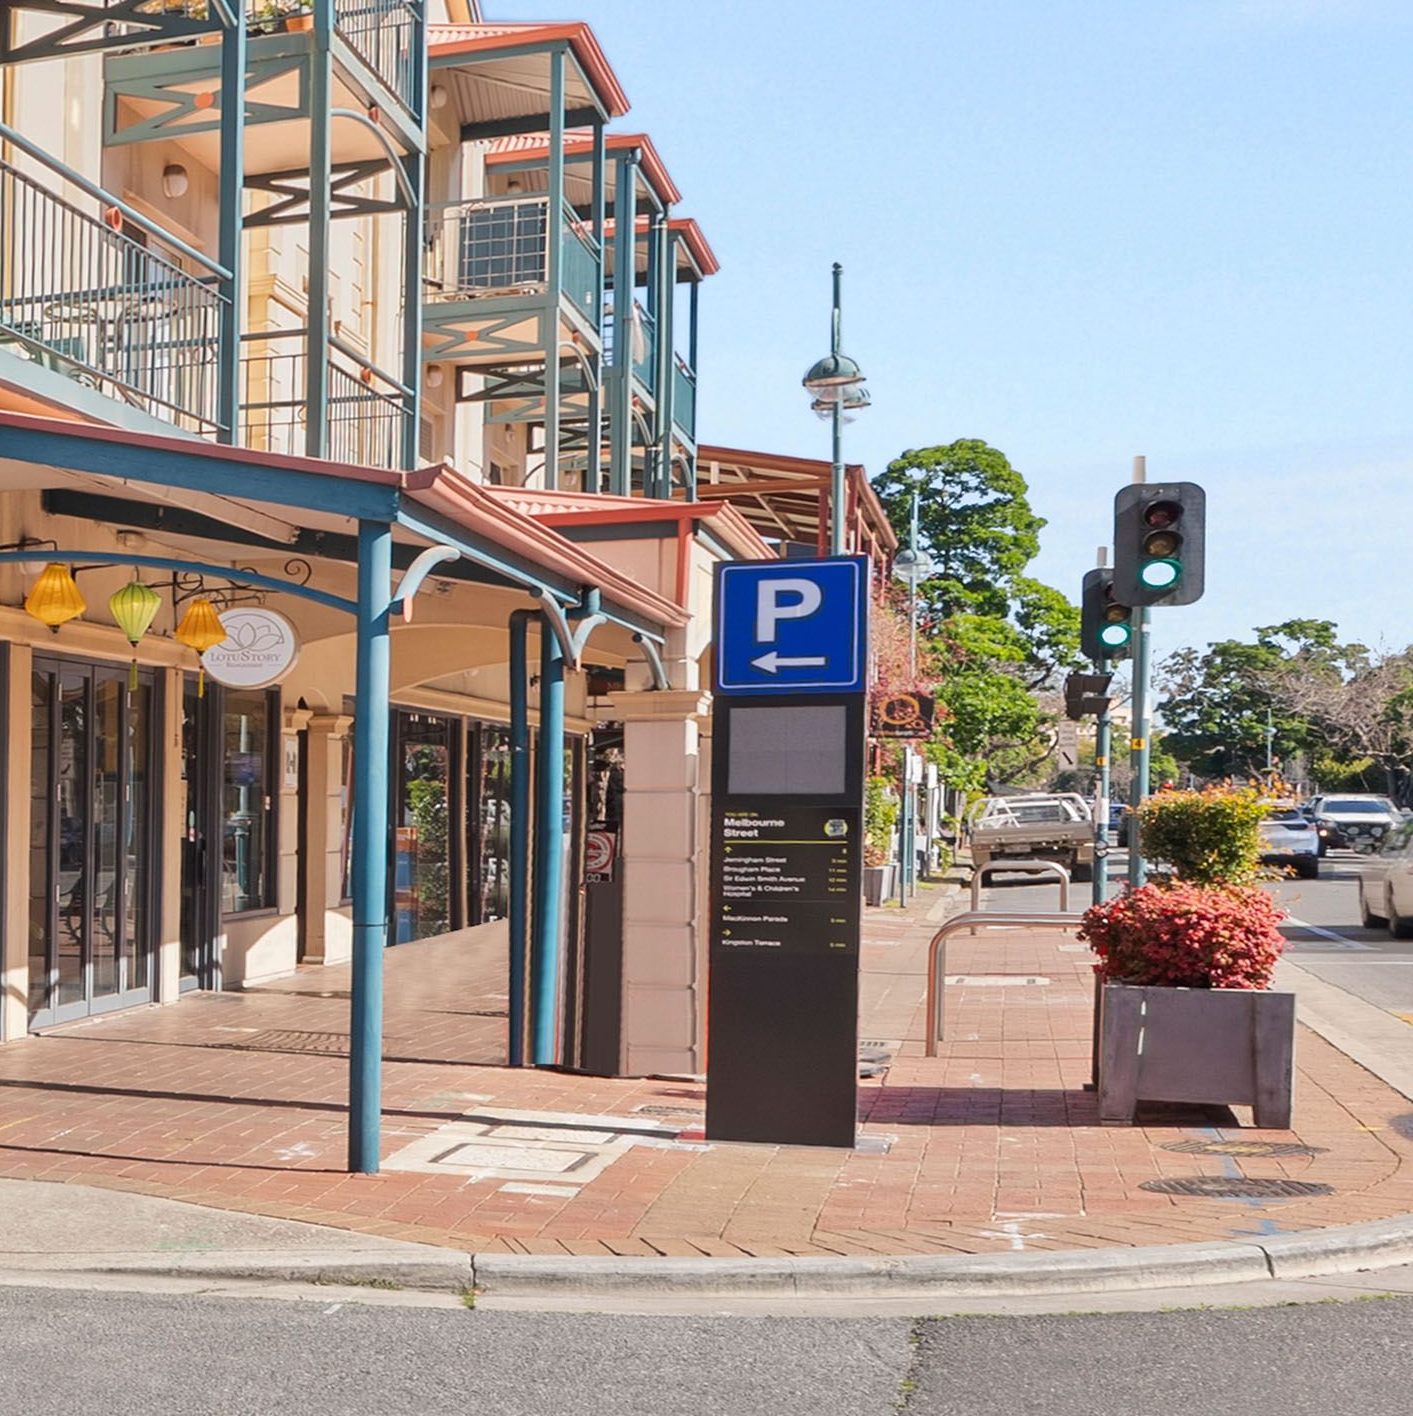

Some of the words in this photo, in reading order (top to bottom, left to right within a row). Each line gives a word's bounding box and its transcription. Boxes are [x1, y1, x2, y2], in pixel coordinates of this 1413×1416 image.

[757, 578, 822, 642] P
[723, 818, 786, 827] Melbourne
[723, 828, 759, 837] Street
